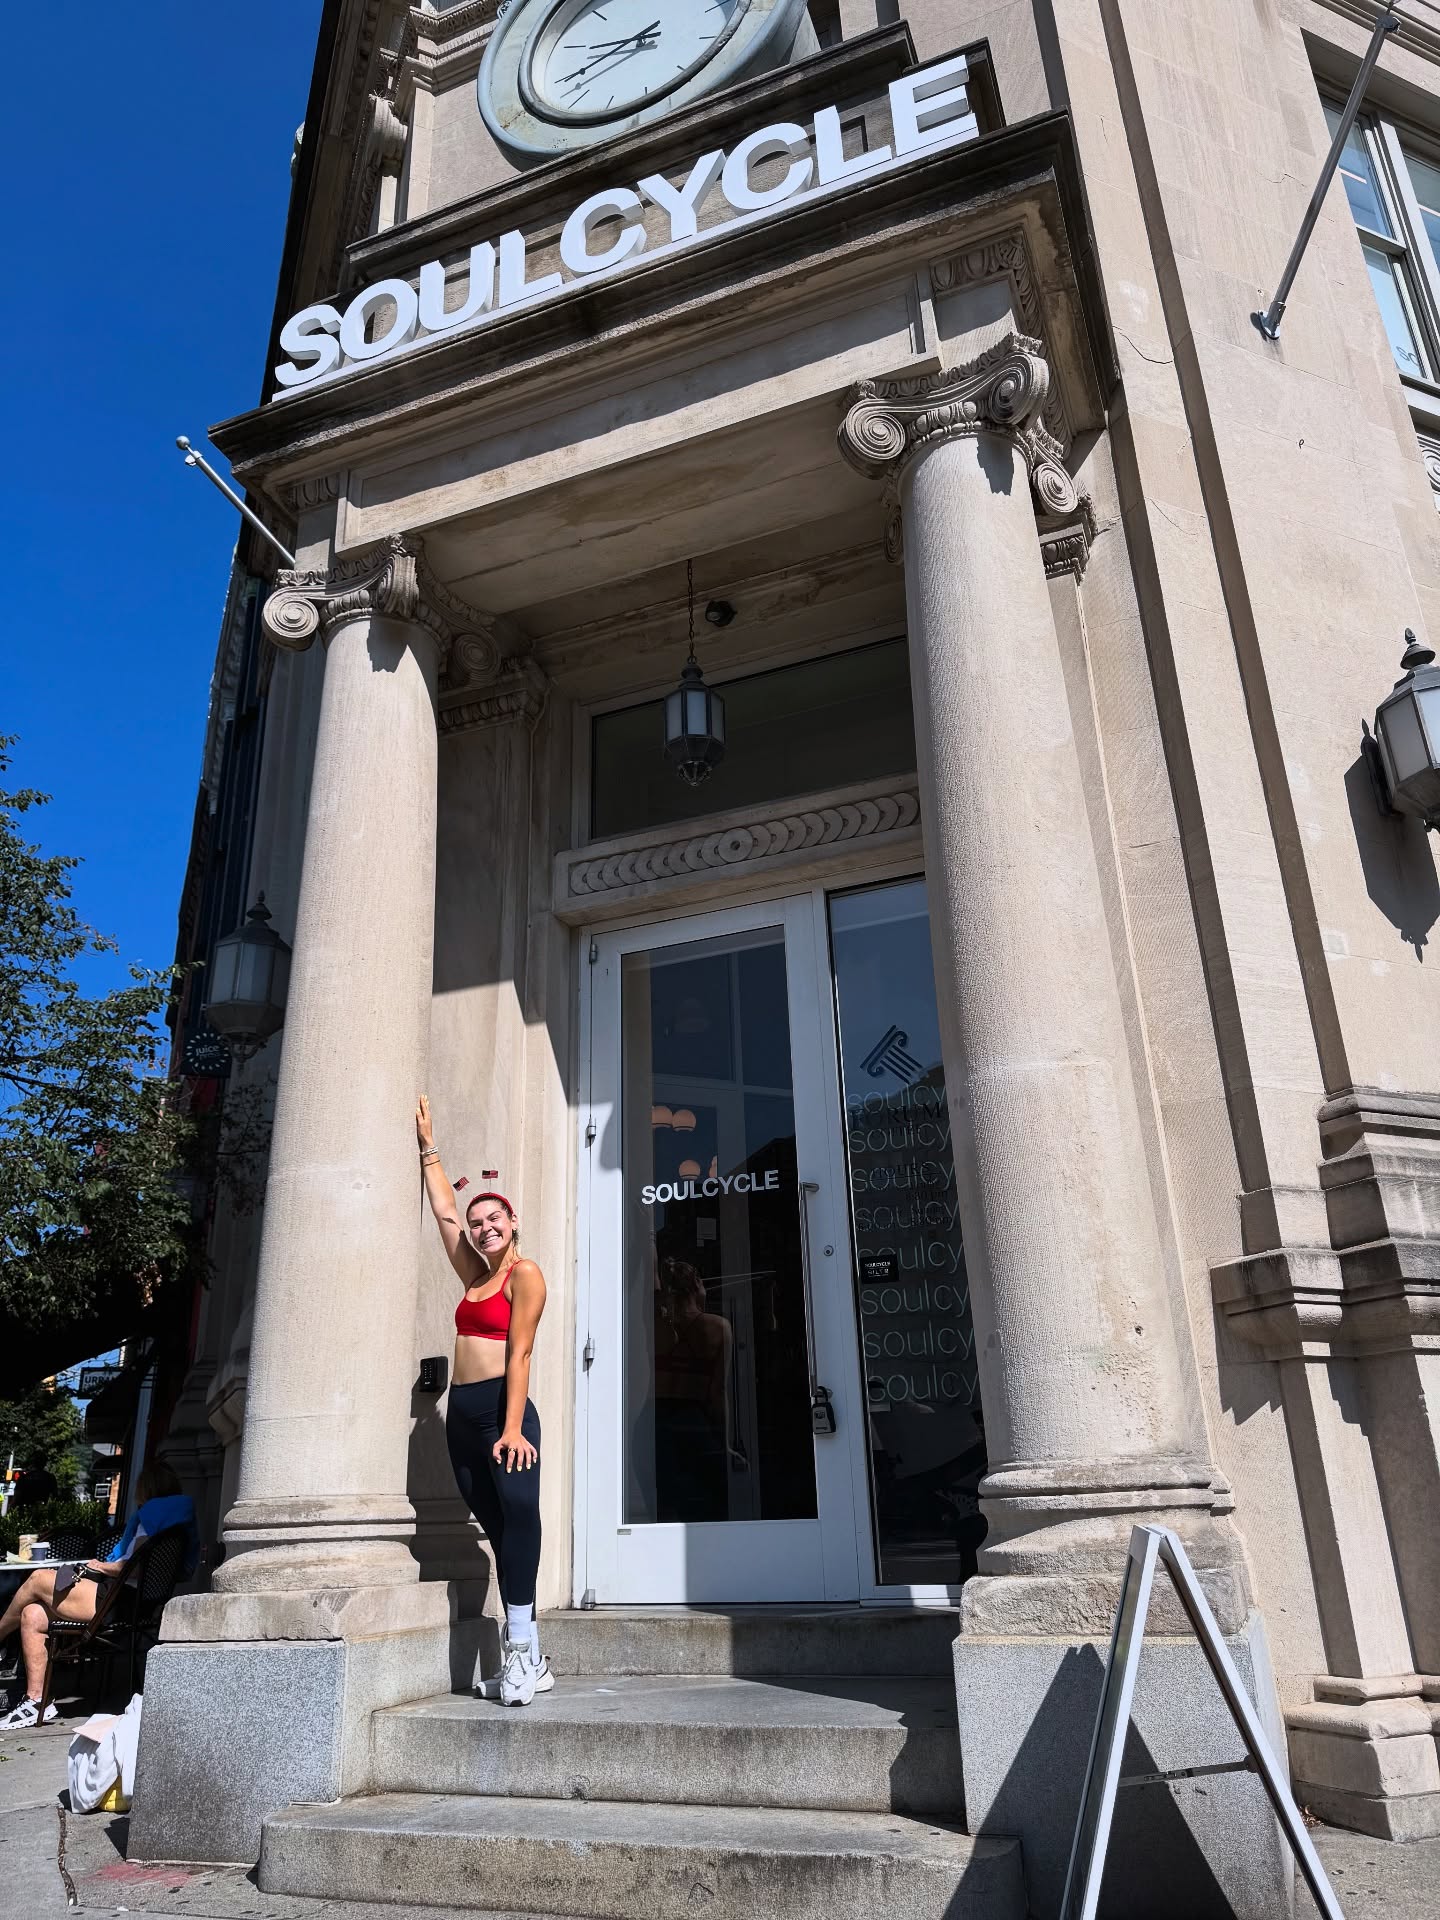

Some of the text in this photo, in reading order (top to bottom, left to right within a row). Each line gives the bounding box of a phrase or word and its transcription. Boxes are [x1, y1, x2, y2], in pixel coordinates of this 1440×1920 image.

[275, 55, 980, 386] SOULCYCLE
[849, 1118, 951, 1153] soulcy
[641, 1169, 780, 1205] SOULCYCLE
[851, 1156, 955, 1192] soulcy
[861, 1279, 968, 1318] soulcy
[864, 1320, 974, 1361] soulcy
